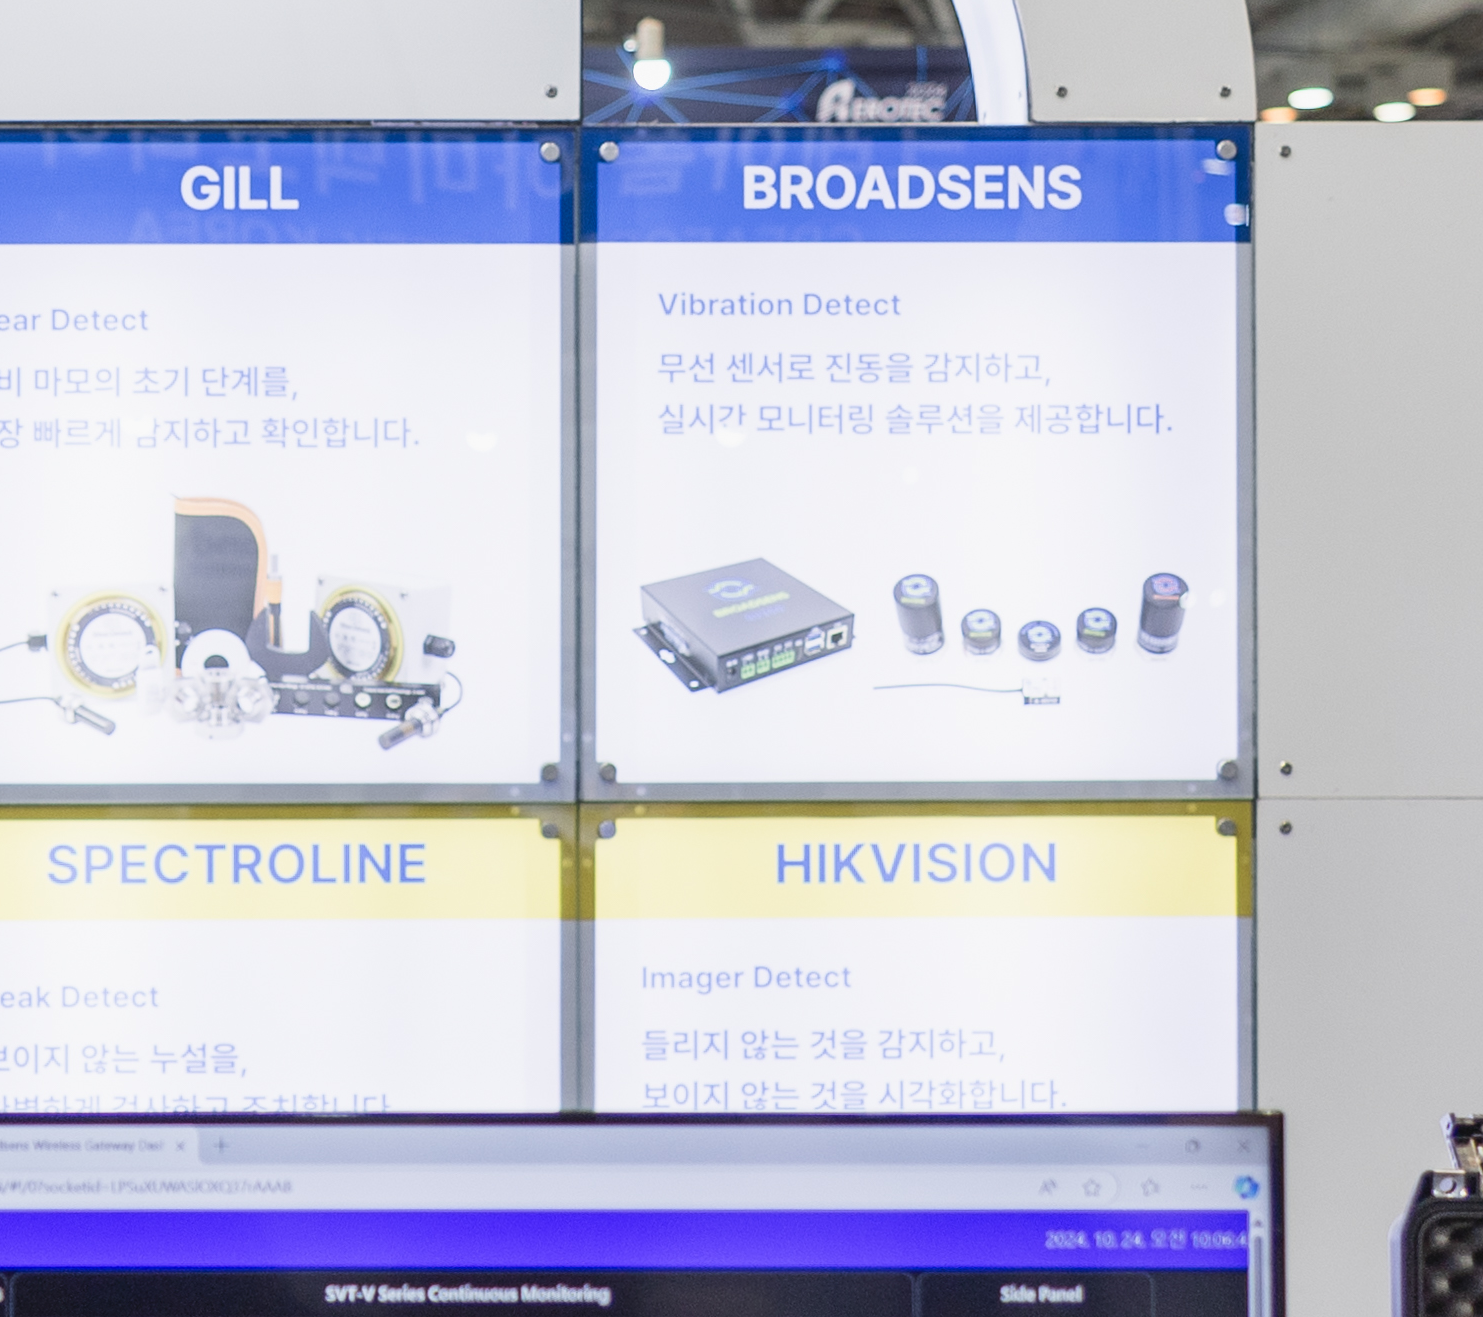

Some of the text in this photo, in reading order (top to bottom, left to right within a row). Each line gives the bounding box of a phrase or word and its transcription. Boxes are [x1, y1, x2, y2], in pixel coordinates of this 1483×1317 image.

[180, 165, 300, 211] GILL
[741, 163, 1083, 212] BROADSENS
[51, 308, 150, 331] Detect
[658, 292, 902, 316] Vibration Detect
[33, 366, 120, 398] 마모의
[133, 366, 189, 398] 초기
[201, 366, 298, 401] 단계를,
[658, 352, 1050, 388] 무선 센서로 진동을 감지하고,
[33, 417, 121, 449] 빠르게
[261, 417, 420, 449] 확인합니다.
[658, 403, 1173, 435] 실시간 모니터링 솔루션을 제공합니다.
[46, 843, 428, 885] SPECTROLINE
[776, 842, 1059, 883] HIKVISION
[642, 966, 852, 995] Imager Detect
[61, 985, 160, 1009] Detect
[81, 1043, 139, 1074] 않는
[150, 1043, 247, 1077] 누설을,
[641, 1028, 1005, 1063] 들리지 않는 것을 감지하고,
[641, 1079, 1068, 1111] 보이지 않는 것을 시각화합니다.
[377, 1285, 426, 1303] Series
[427, 1285, 519, 1304] Continuous
[521, 1284, 613, 1308] Monitoring
[999, 1284, 1084, 1303] Side Panel
